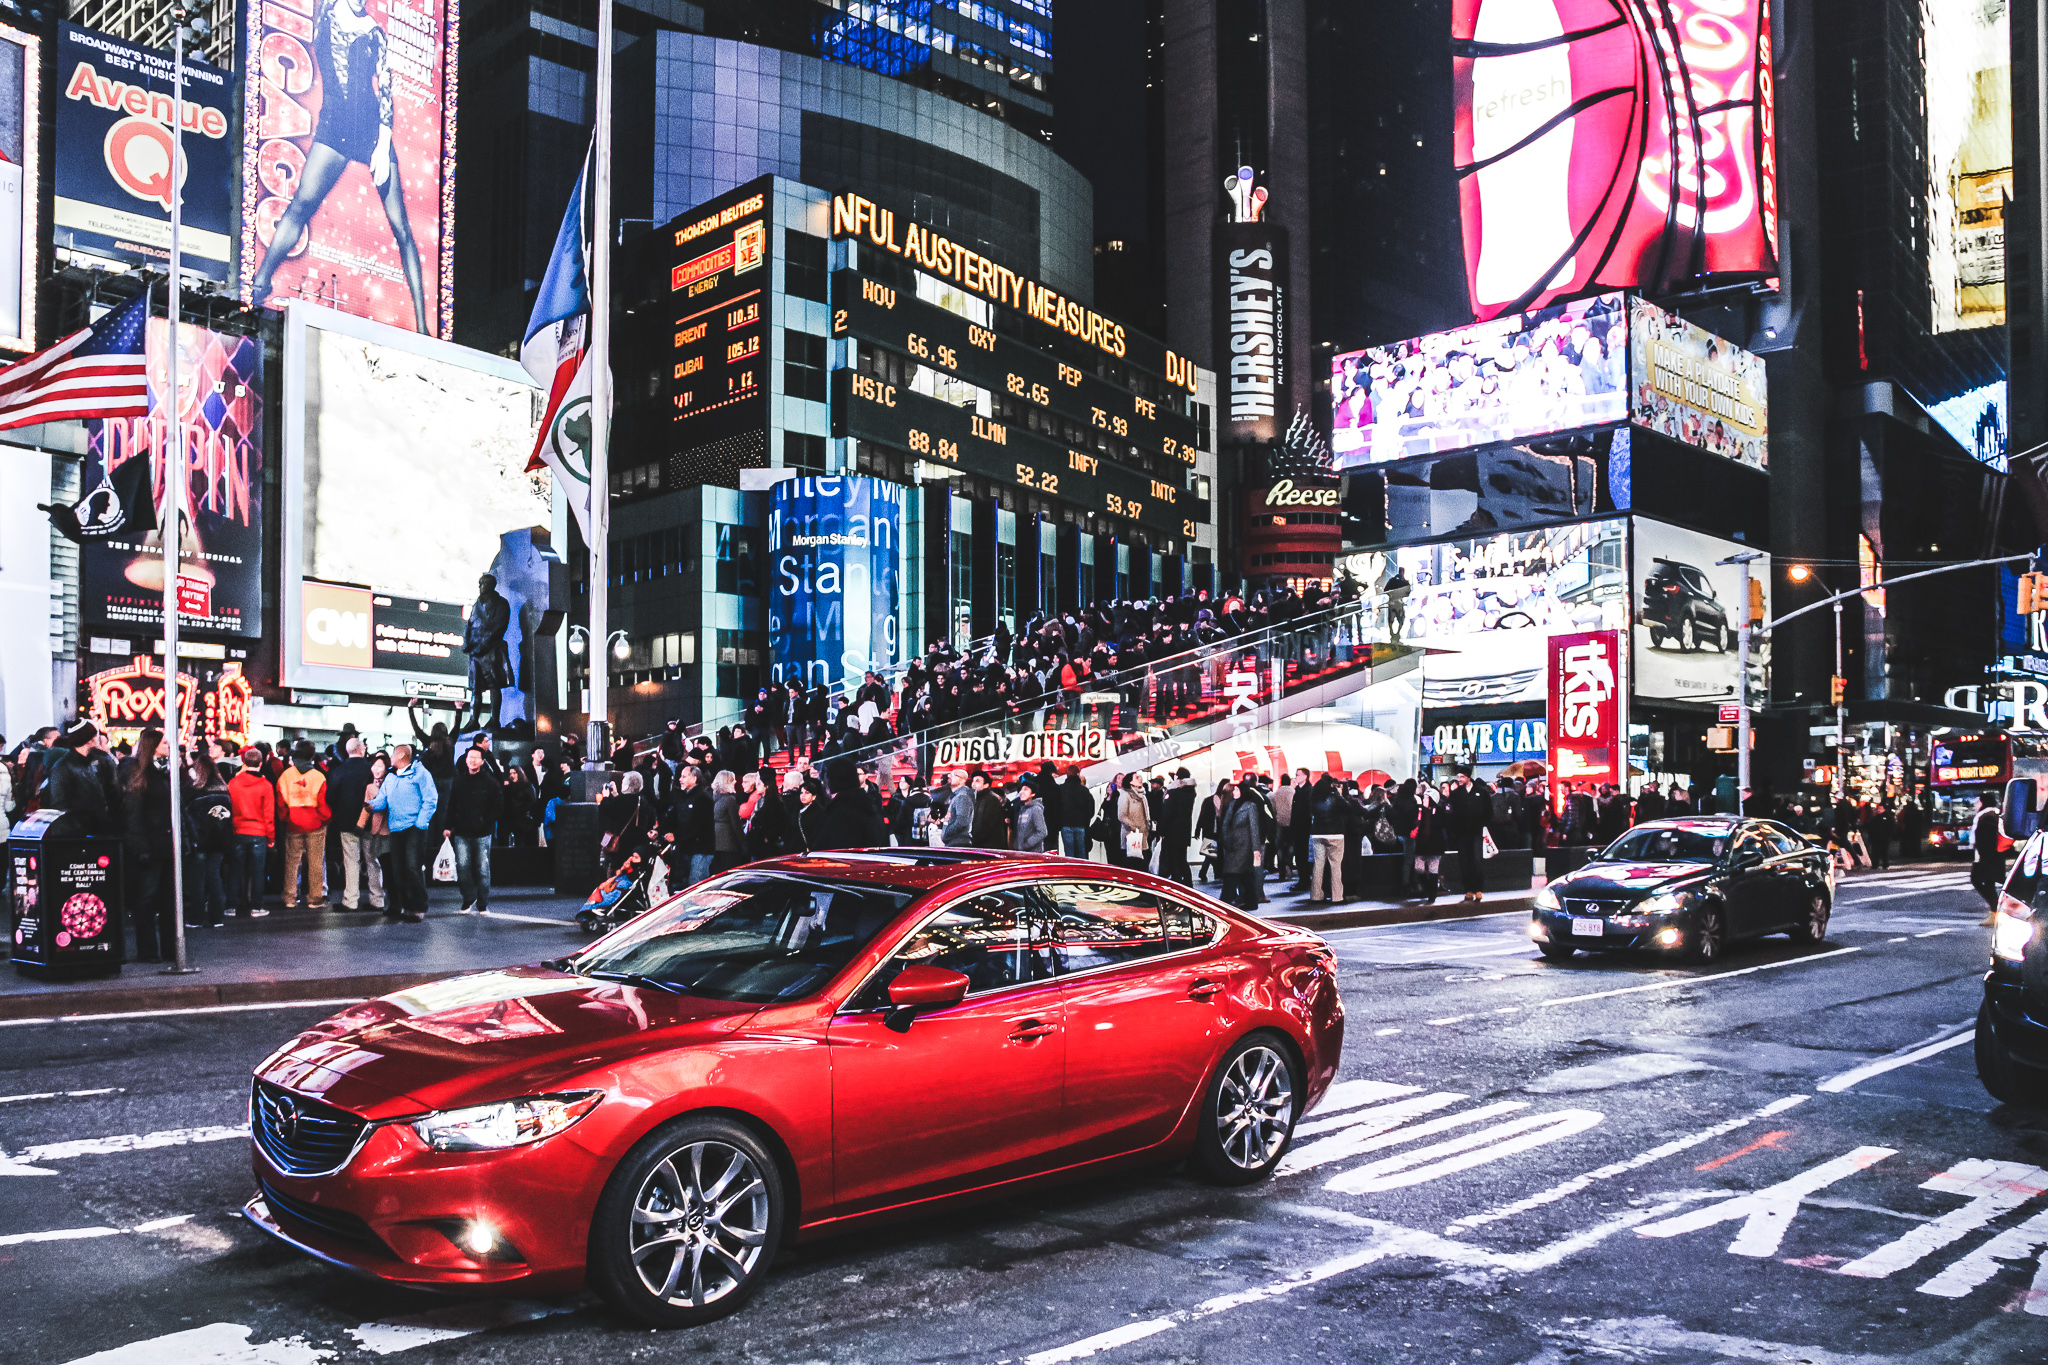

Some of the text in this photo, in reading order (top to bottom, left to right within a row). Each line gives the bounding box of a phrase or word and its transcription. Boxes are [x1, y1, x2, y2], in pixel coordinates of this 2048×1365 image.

[69, 31, 142, 62] BROADWAY'S
[105, 53, 136, 72] BEST
[66, 62, 227, 139] Avenue
[1476, 74, 1565, 123] refresh
[104, 116, 188, 213] Q
[675, 194, 764, 246] THOMSON REUTERS
[676, 249, 731, 285] COMMODITIES
[834, 192, 901, 253] NFUL
[904, 222, 1025, 309] AUSTERITY
[1027, 280, 1126, 358] MEASURES
[674, 303, 759, 348] BRENT 110.51
[862, 278, 1157, 421] NOV OXY PEP PFE
[1229, 249, 1275, 417] HERSHEY'S
[674, 336, 760, 379] DUBAI 105.12
[1654, 342, 1740, 401] MAKE A PLAYDATE
[907, 332, 958, 370] 66.96
[1006, 372, 1050, 406] 82.65
[1091, 406, 1128, 437] 75.93
[1163, 437, 1196, 464] 27.39
[1654, 366, 1757, 430] WITH YOUR OWN KIDS.
[852, 374, 1177, 504] HSIC ILMN INFY INTC
[908, 429, 1196, 538] 88.84 52.22 53.97 21
[197, 552, 243, 564] MUSICAL
[792, 533, 868, 548] Morgan Stanley
[306, 607, 368, 649] CNN
[1434, 723, 1493, 754] OLIVE
